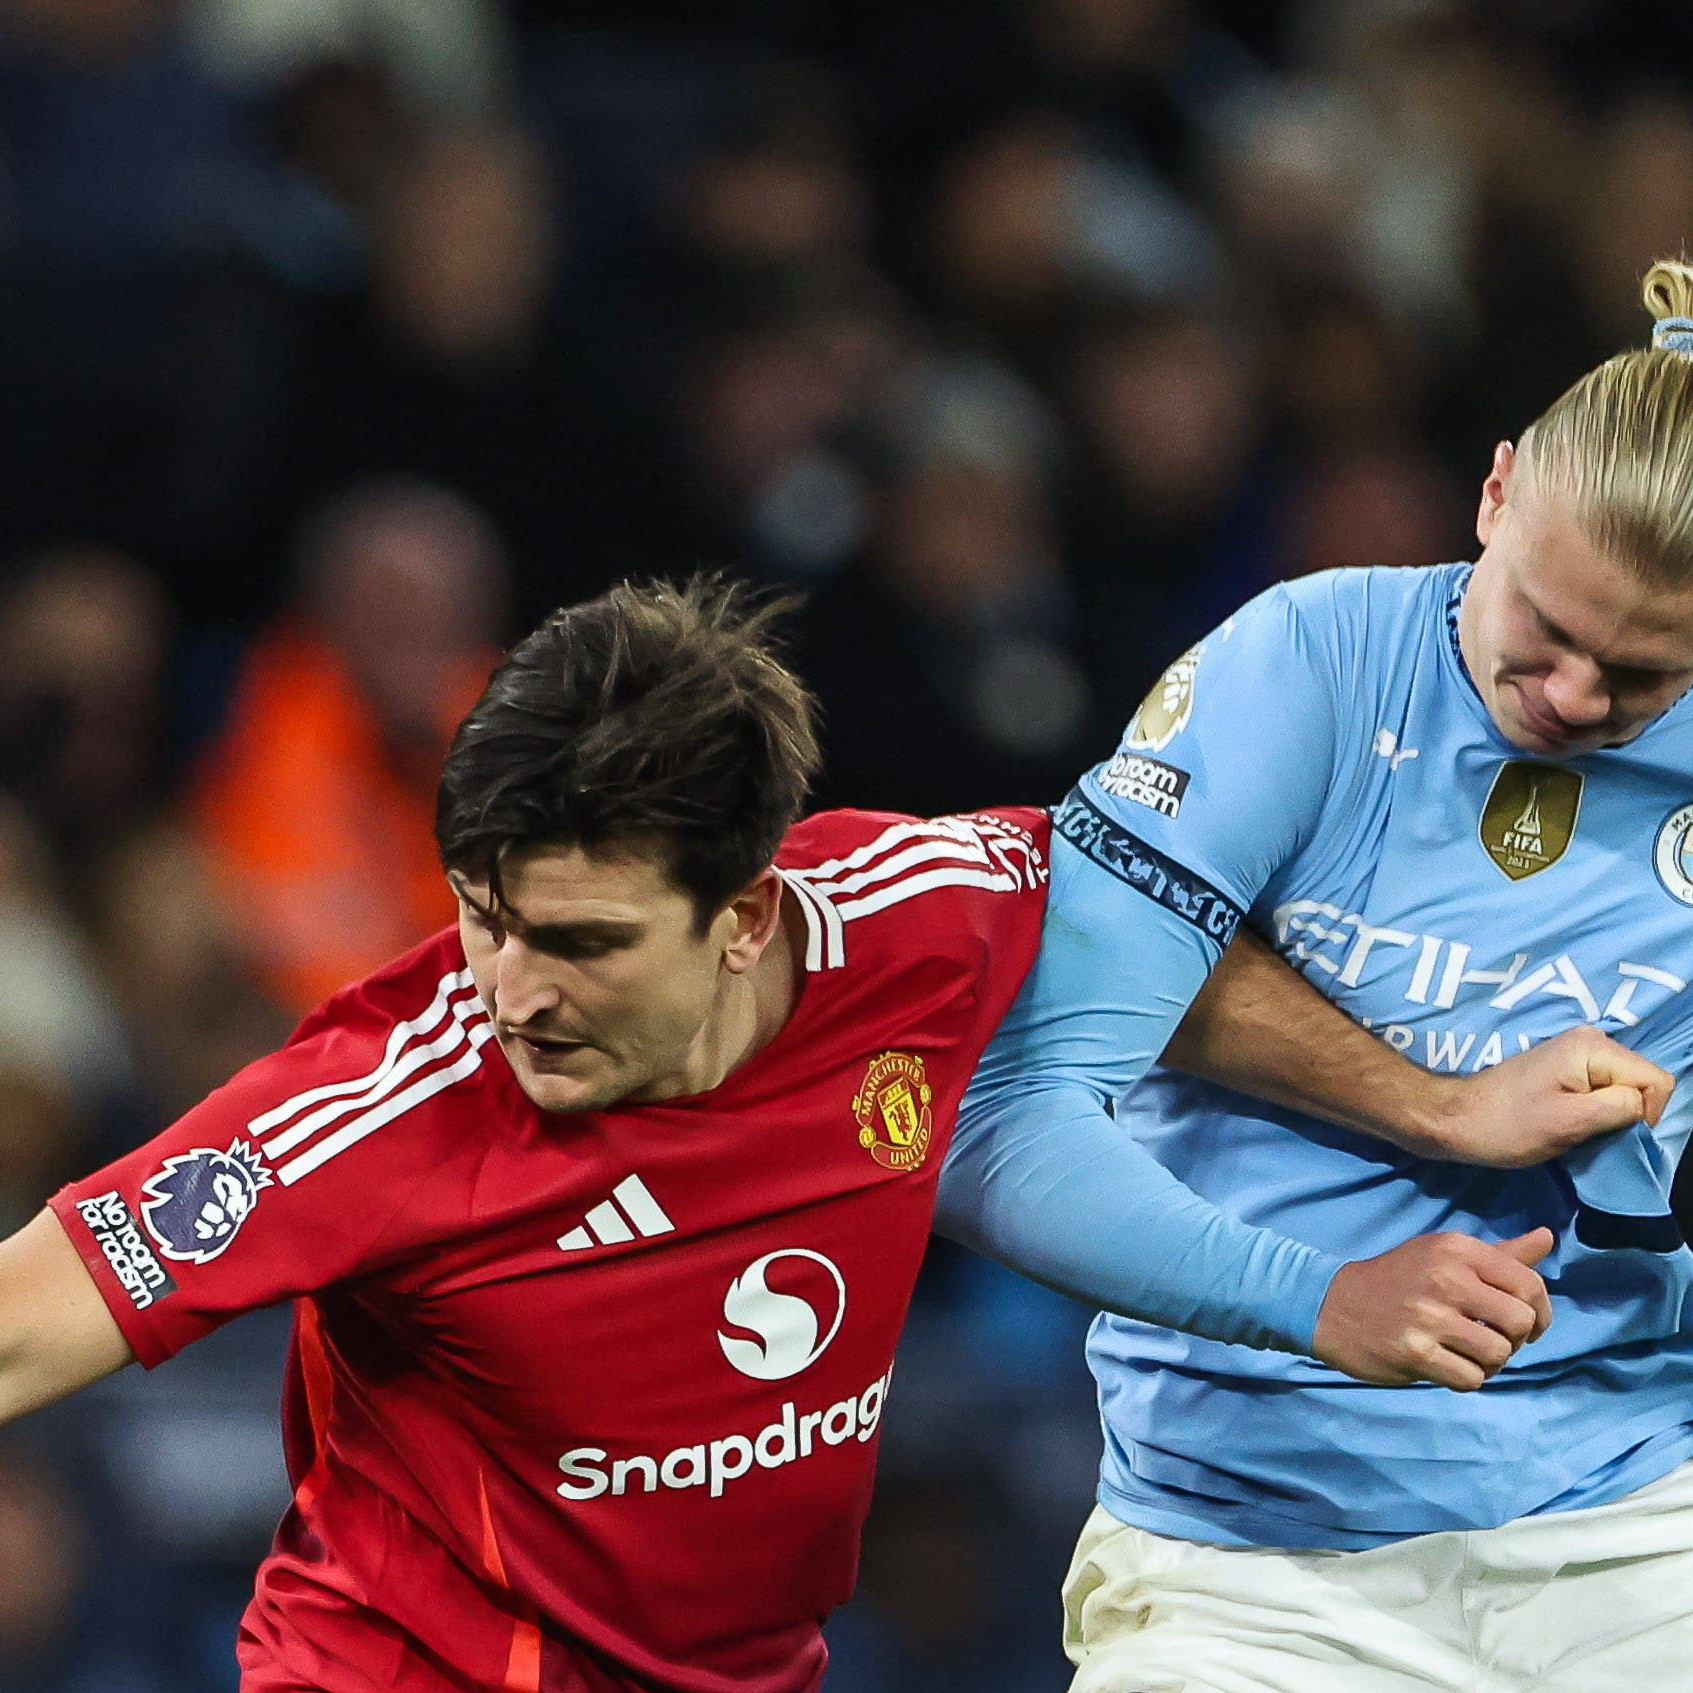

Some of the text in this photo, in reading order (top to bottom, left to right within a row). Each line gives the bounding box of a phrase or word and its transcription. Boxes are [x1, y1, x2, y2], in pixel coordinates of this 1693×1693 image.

[1503, 831, 1543, 855] FIFA
[861, 1059, 921, 1117] MANCHESTER
[890, 1128, 929, 1165] UNITED
[76, 1198, 153, 1310] for racism
[96, 1190, 166, 1289] No room
[556, 1359, 894, 1500] Snapdrag
